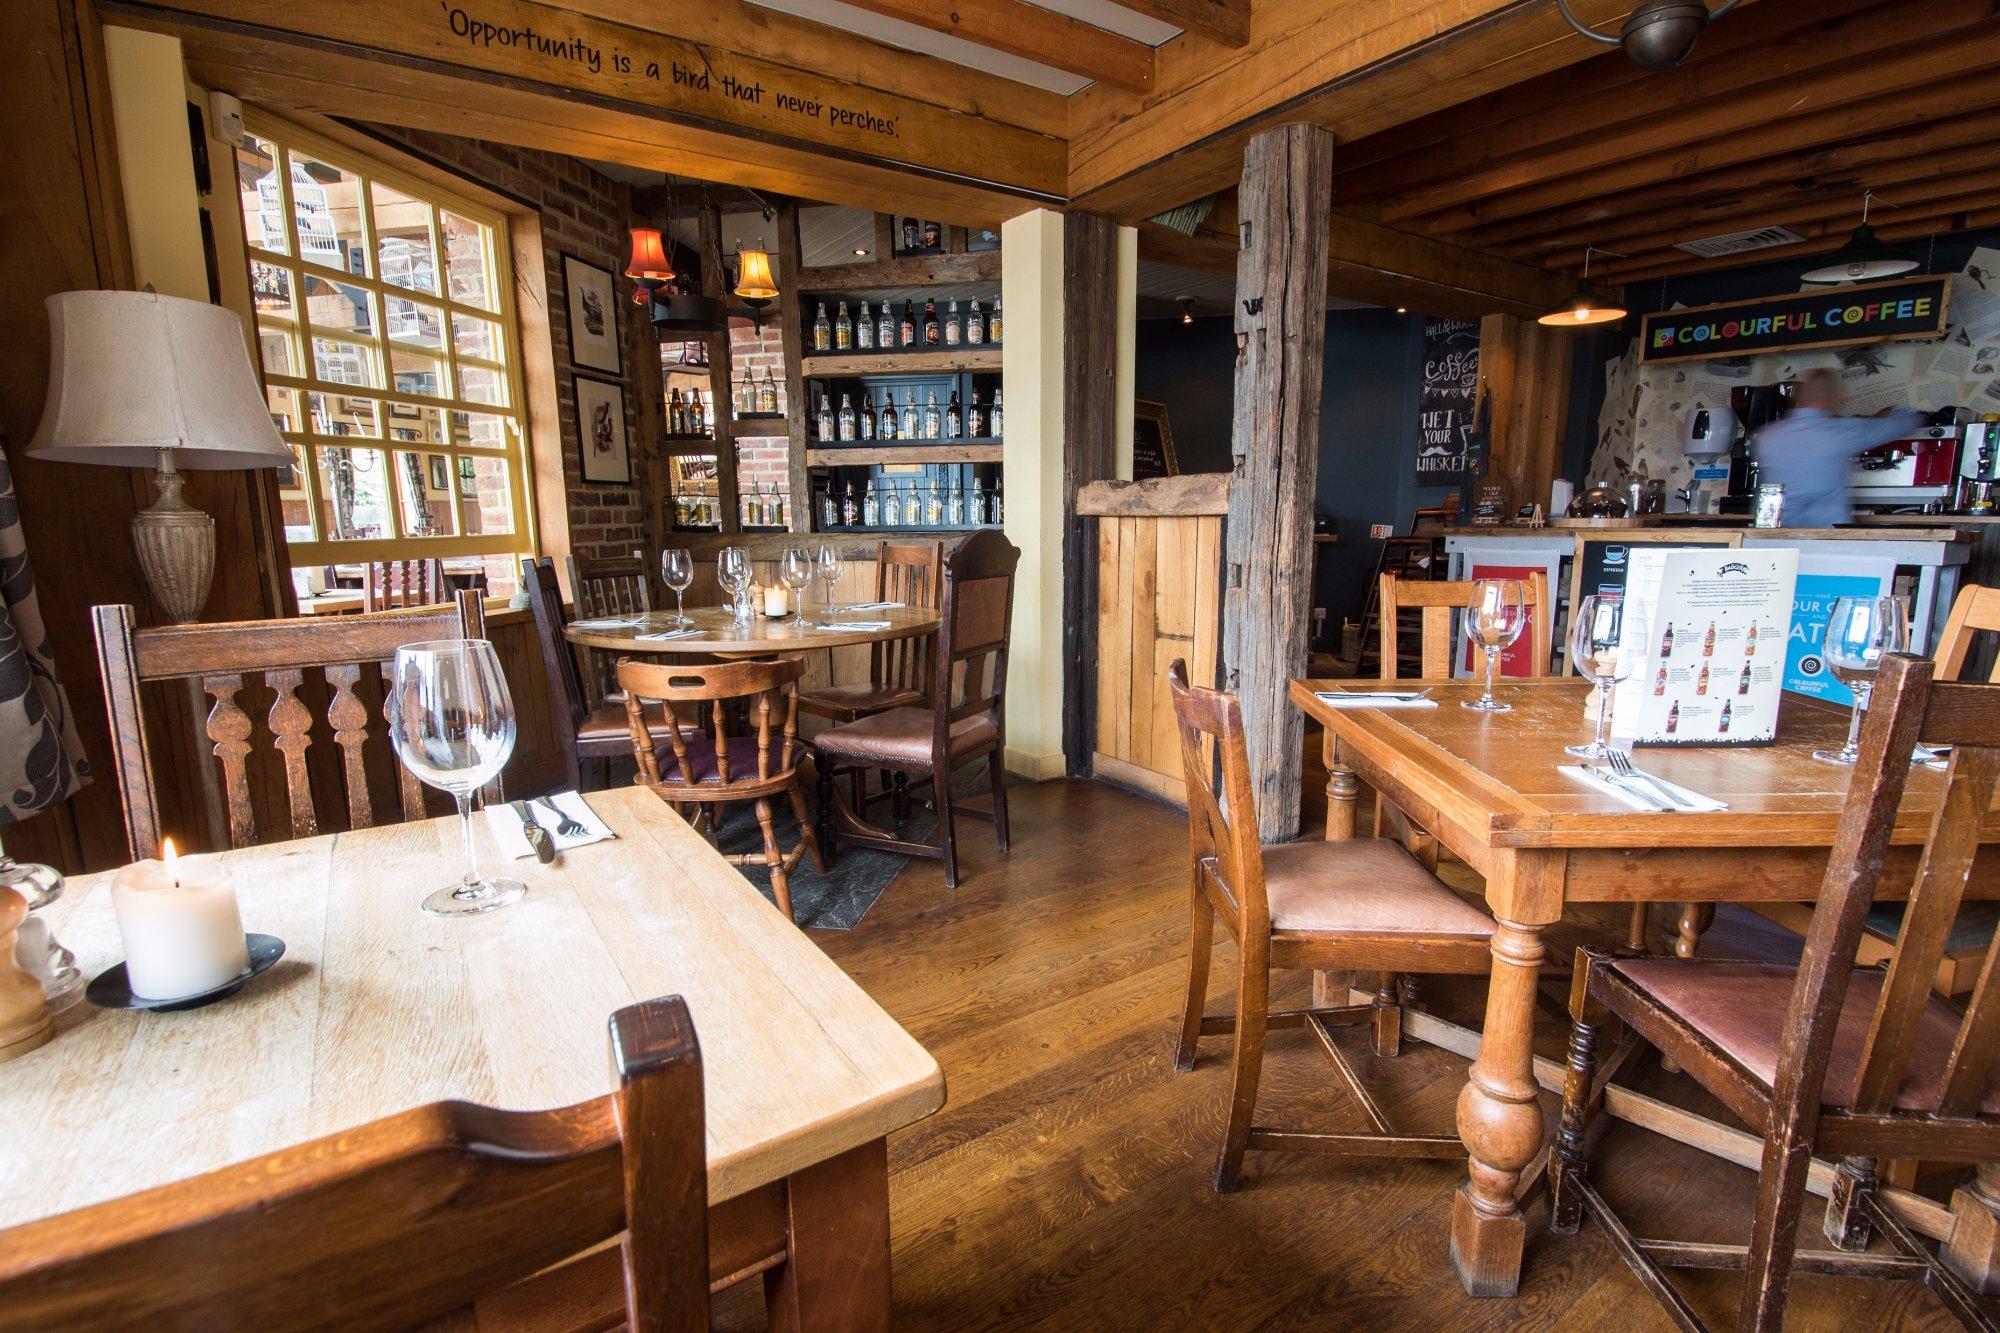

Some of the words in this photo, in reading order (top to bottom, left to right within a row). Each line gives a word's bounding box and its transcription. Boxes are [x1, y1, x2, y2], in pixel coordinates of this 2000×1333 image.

[612, 47, 632, 75] is
[645, 63, 660, 81] a
[672, 61, 710, 92] bird
[722, 75, 766, 105] that
[776, 93, 824, 119] never
[1677, 311, 1818, 344] COLOURFUL
[1823, 296, 1933, 326] COFFEE
[1421, 409, 1456, 430] WET
[1423, 429, 1452, 445] YOUR
[1788, 678, 1830, 689] COLOURFUL
[1794, 685, 1823, 694] COFFEE
